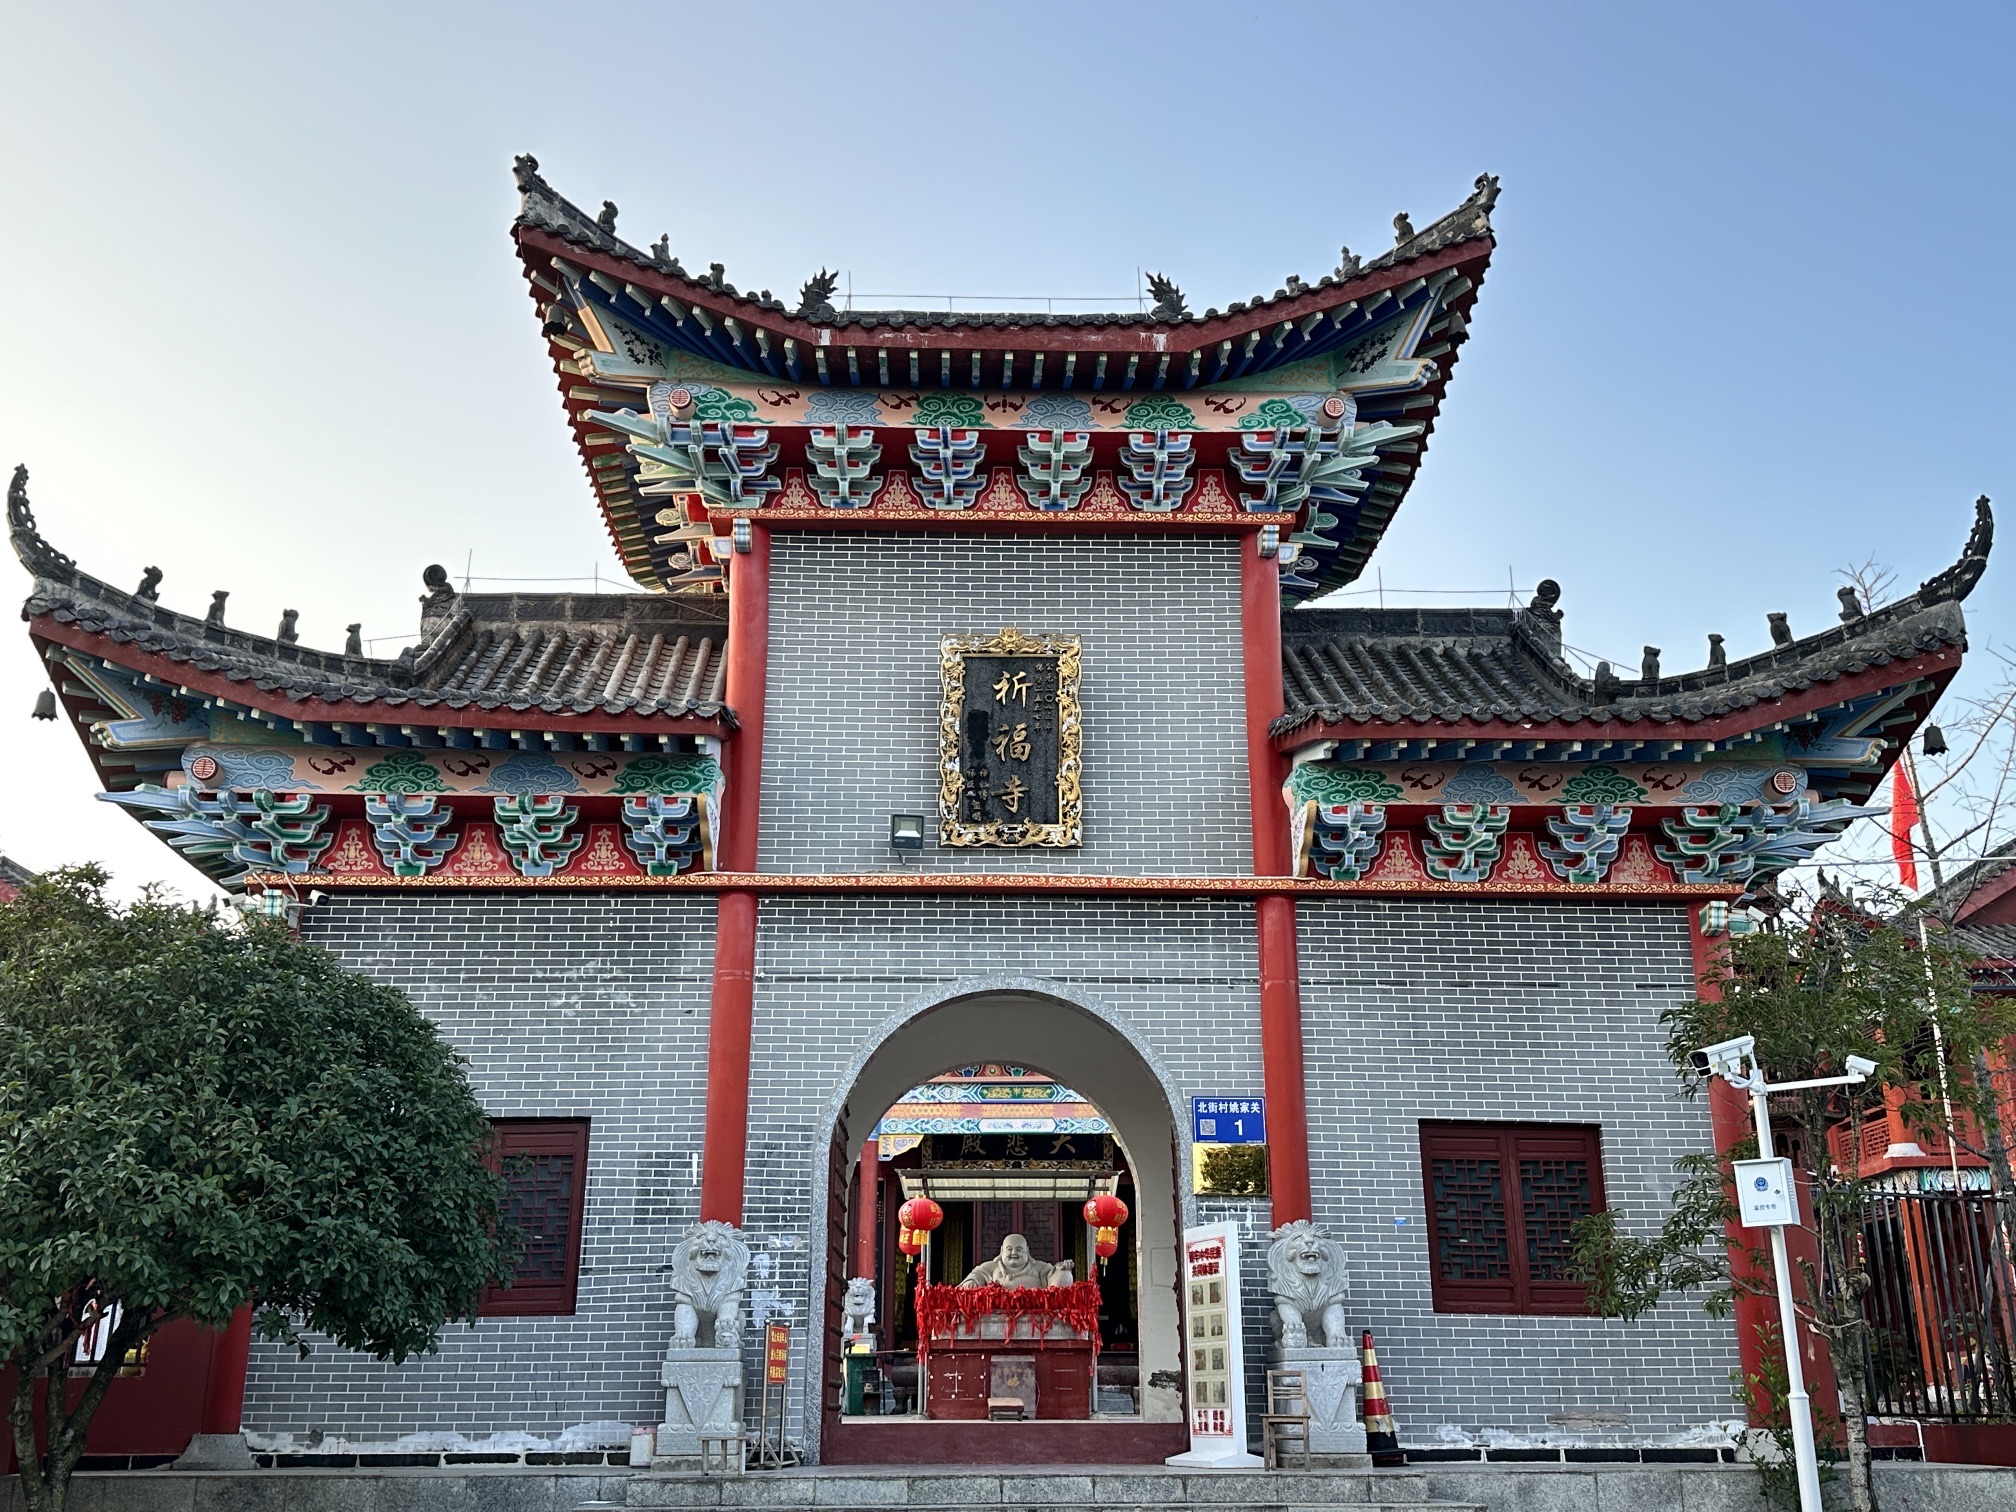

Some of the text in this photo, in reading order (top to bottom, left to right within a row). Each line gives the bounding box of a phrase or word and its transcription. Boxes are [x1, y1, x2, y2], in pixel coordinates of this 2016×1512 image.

[991, 671, 1033, 814] 祈福寺
[1197, 1101, 1261, 1114] 北街村姚家关
[1234, 1119, 1244, 1136] 1
